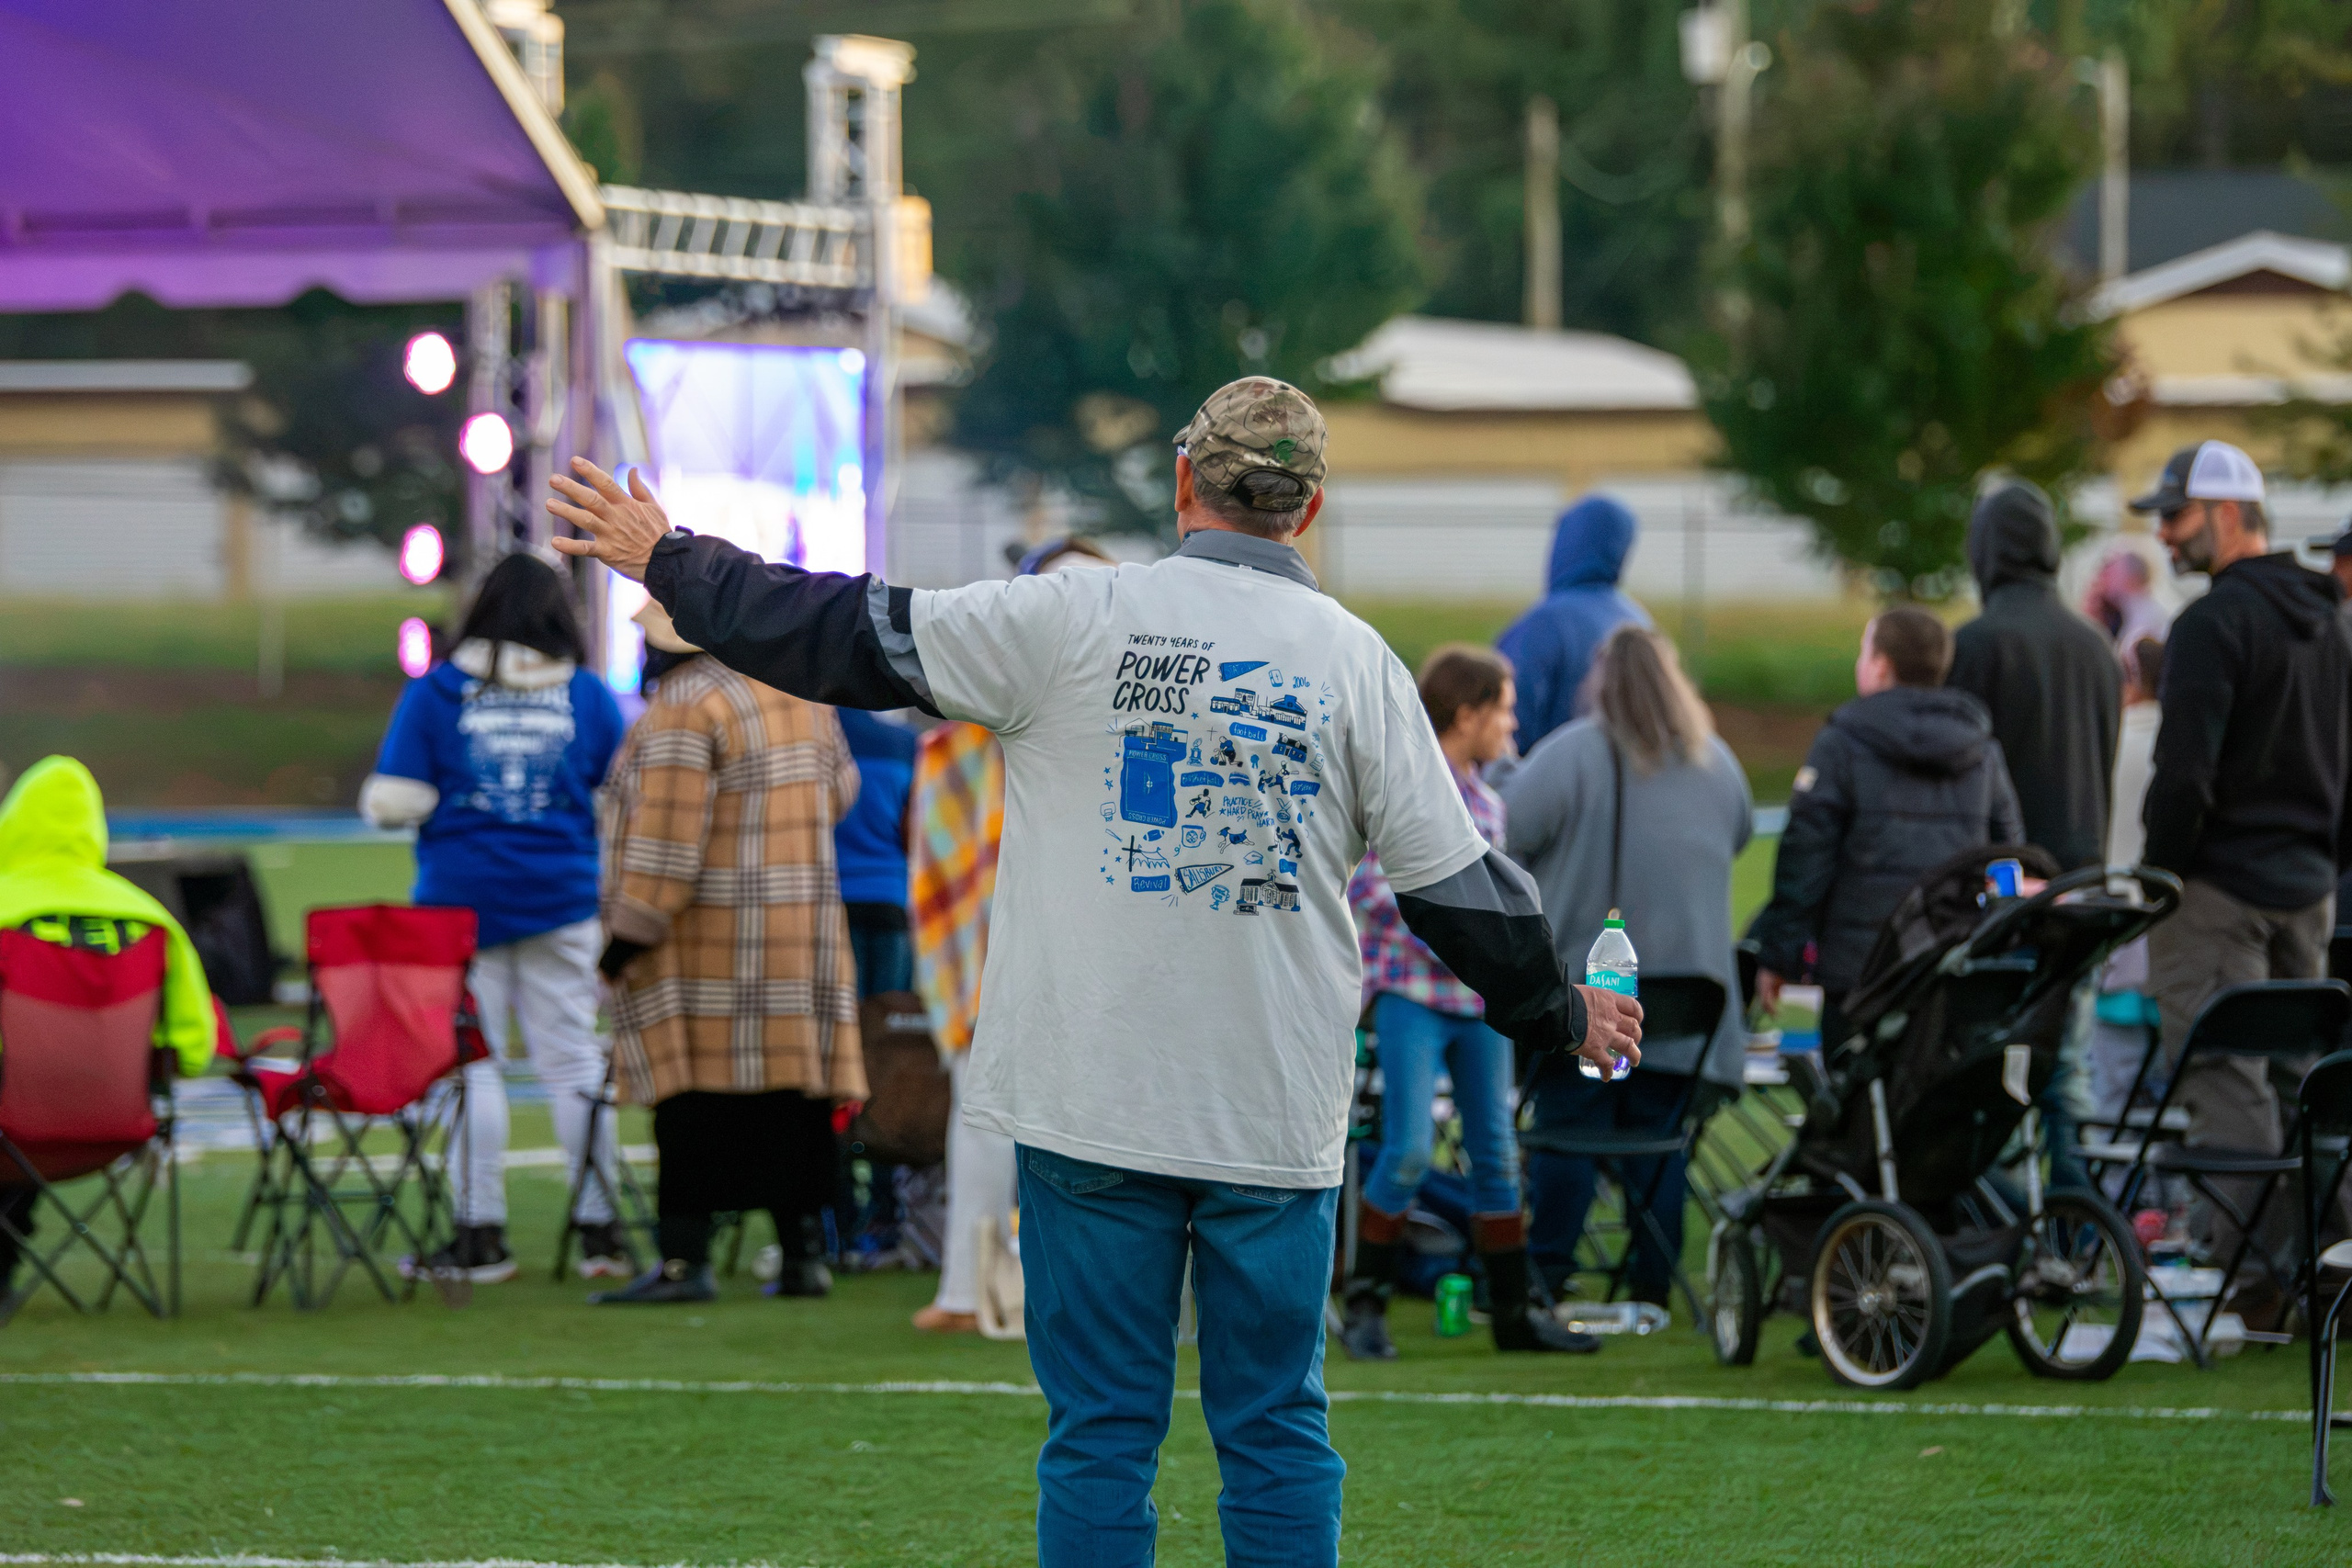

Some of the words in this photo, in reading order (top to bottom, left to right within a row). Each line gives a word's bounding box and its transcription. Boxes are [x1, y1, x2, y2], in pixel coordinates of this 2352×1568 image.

[1128, 634, 1167, 646] TWENTY
[1170, 637, 1199, 649] YEARS
[1201, 642, 1216, 651] OF
[1115, 650, 1211, 685] POWER
[1293, 675, 1310, 689] 2006
[1113, 681, 1190, 715] CROSS
[1128, 750, 1148, 760] POWER
[1148, 751, 1167, 761] CROSS
[1223, 795, 1253, 807] PRACTICE
[1227, 807, 1247, 817] HARD
[1248, 808, 1263, 819] PRAY
[1133, 876, 1168, 890] Revival
[1183, 865, 1223, 889] SALISBURY
[1589, 974, 1620, 987] DASANI
